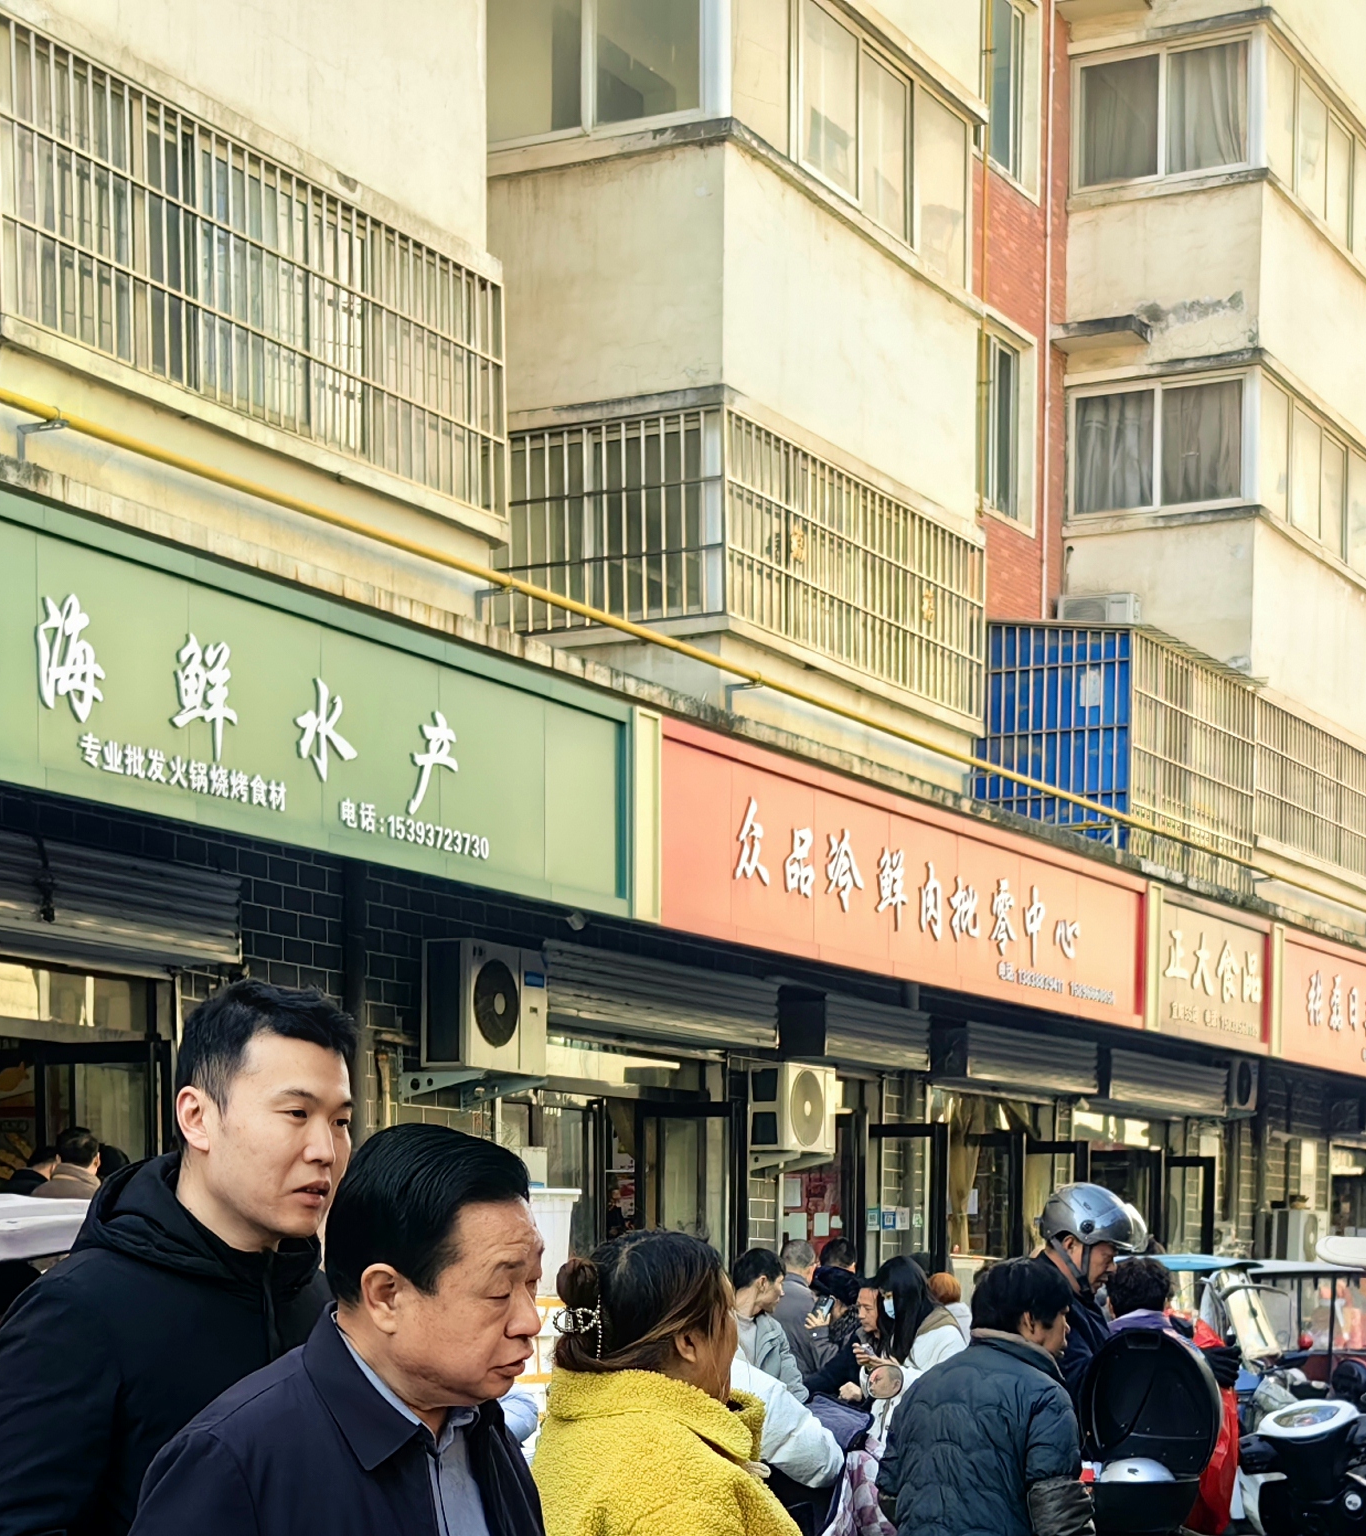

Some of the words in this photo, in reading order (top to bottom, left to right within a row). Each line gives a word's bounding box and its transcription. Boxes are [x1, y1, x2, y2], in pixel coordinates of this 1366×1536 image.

[79, 732, 287, 812] 专业批发火锅烧烤食材
[732, 796, 1081, 969] 众品冷鲜肉批零中心
[1164, 929, 1262, 1004] 正大食品
